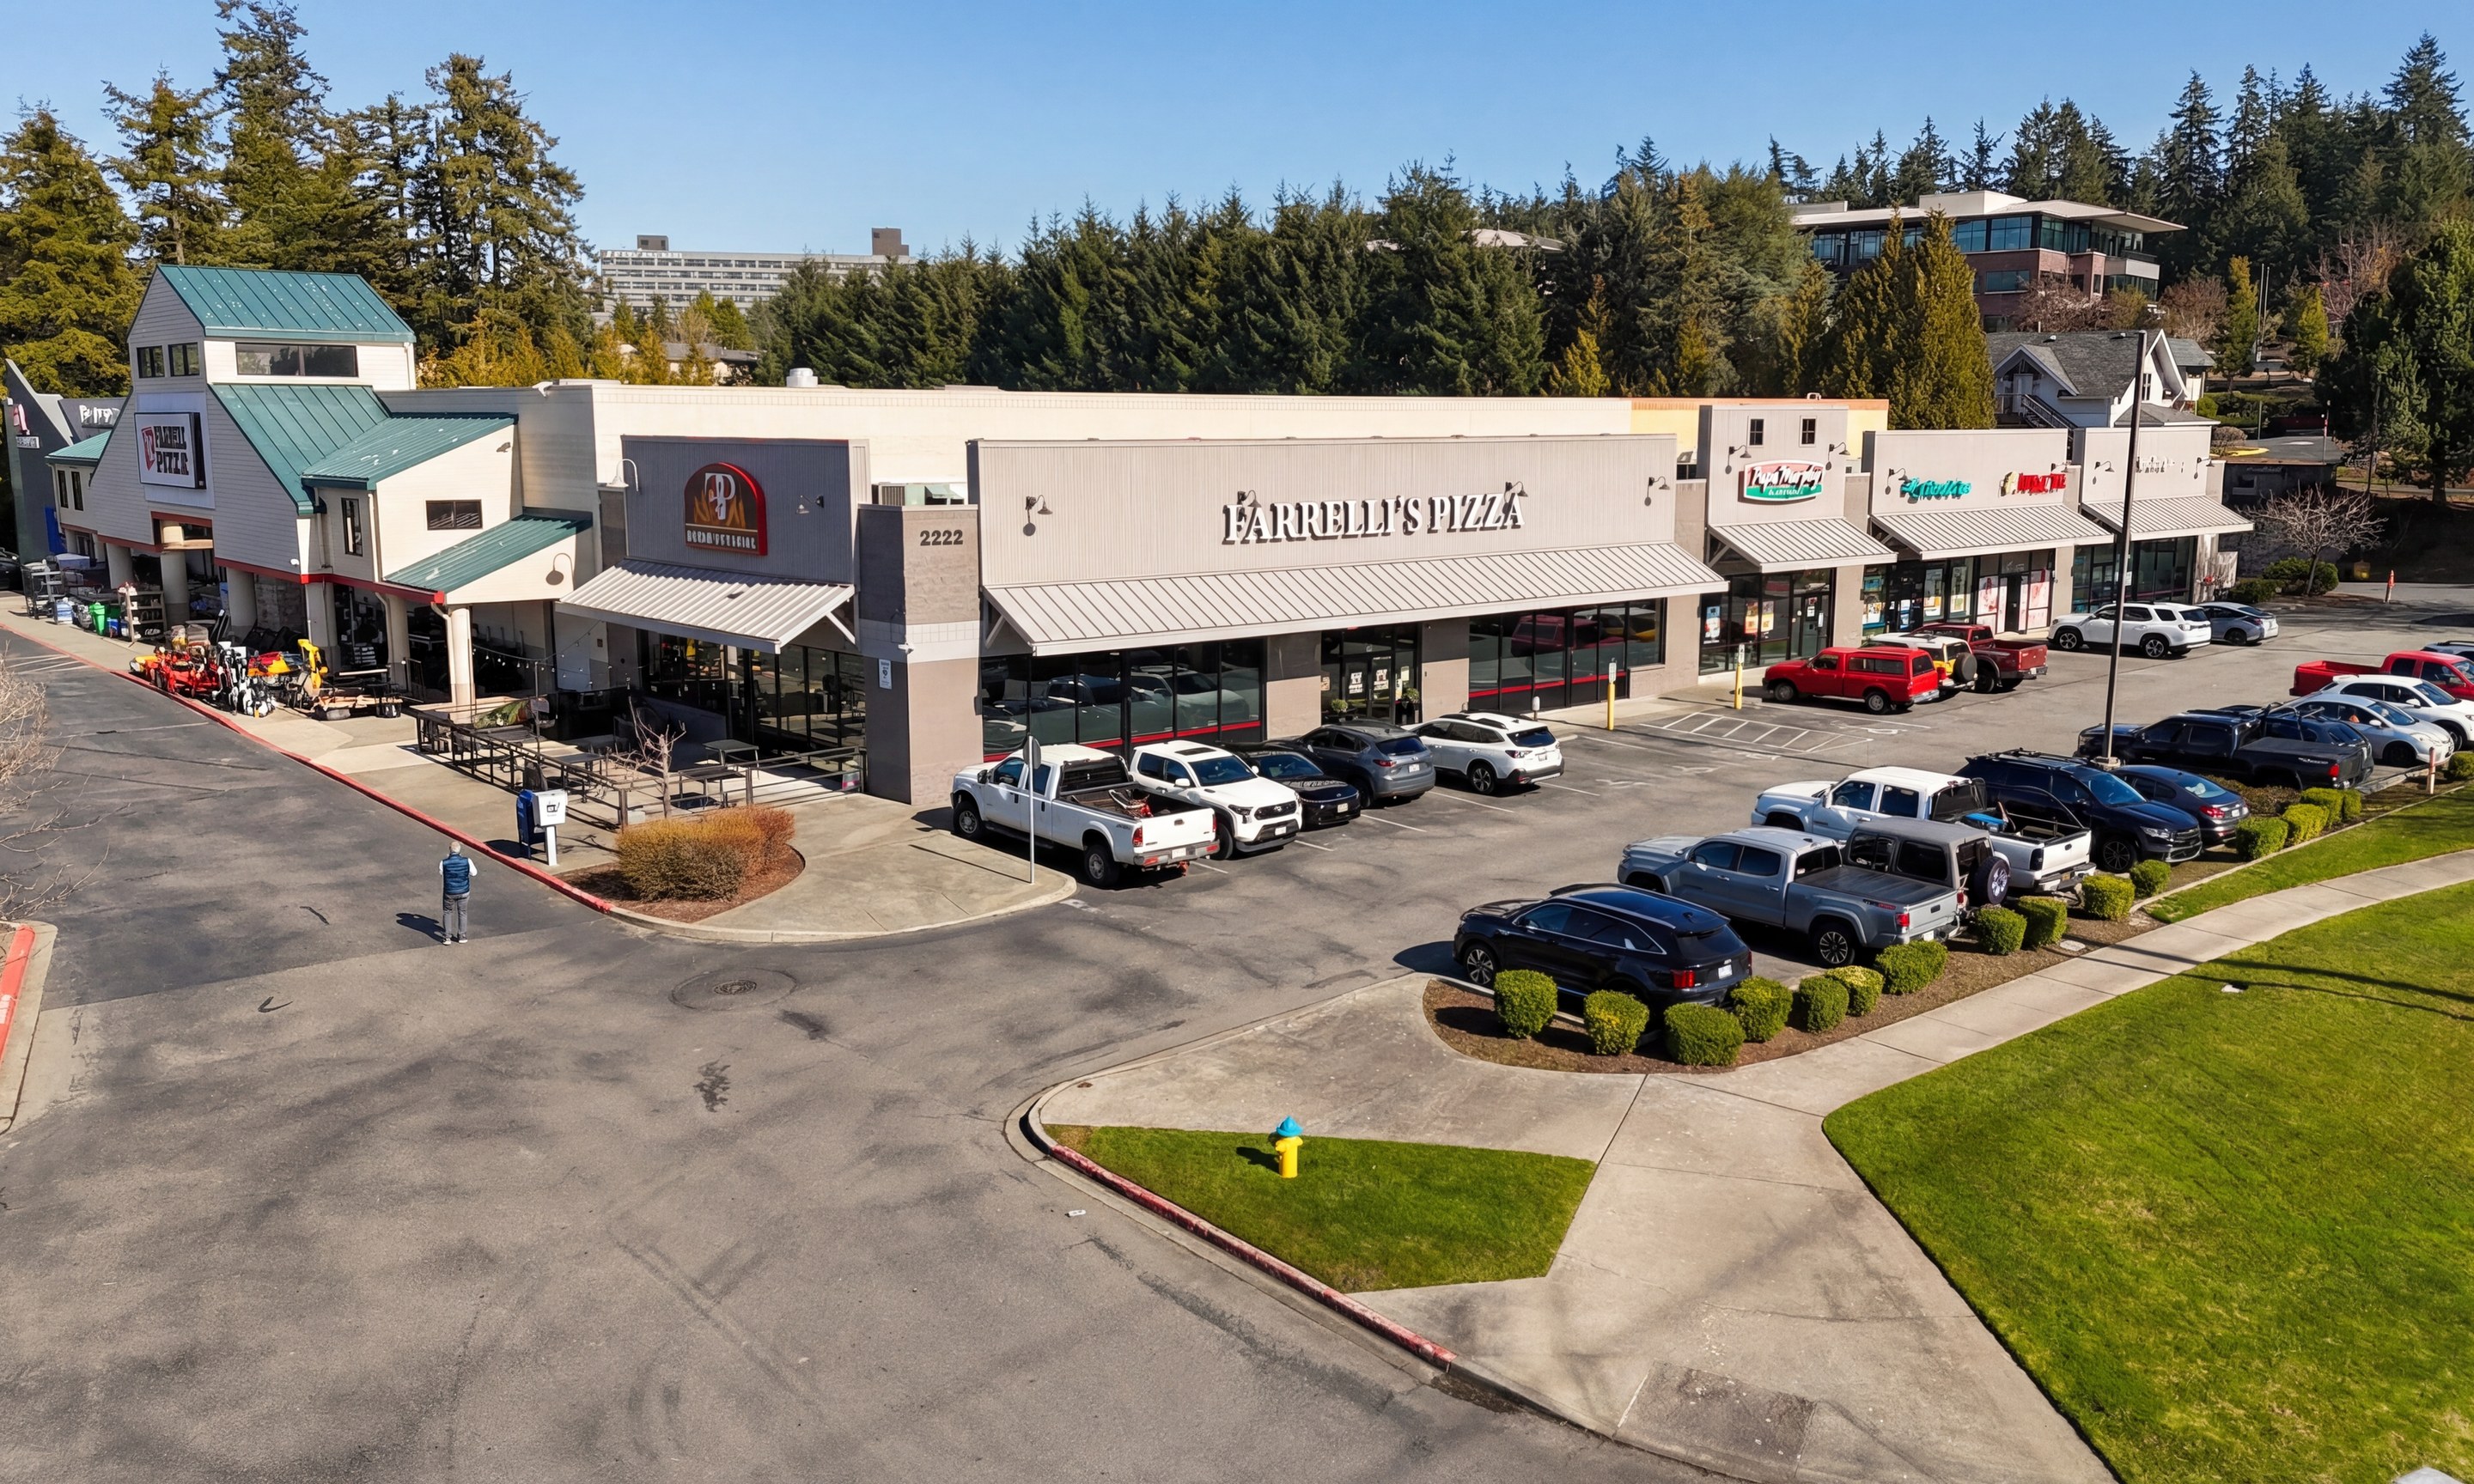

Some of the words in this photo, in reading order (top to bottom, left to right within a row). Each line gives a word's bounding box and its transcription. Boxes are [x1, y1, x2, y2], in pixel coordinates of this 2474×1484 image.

[1224, 495, 1423, 544] FARRELLI'S
[1429, 492, 1524, 533] PIZZA
[920, 529, 963, 546] 2222
